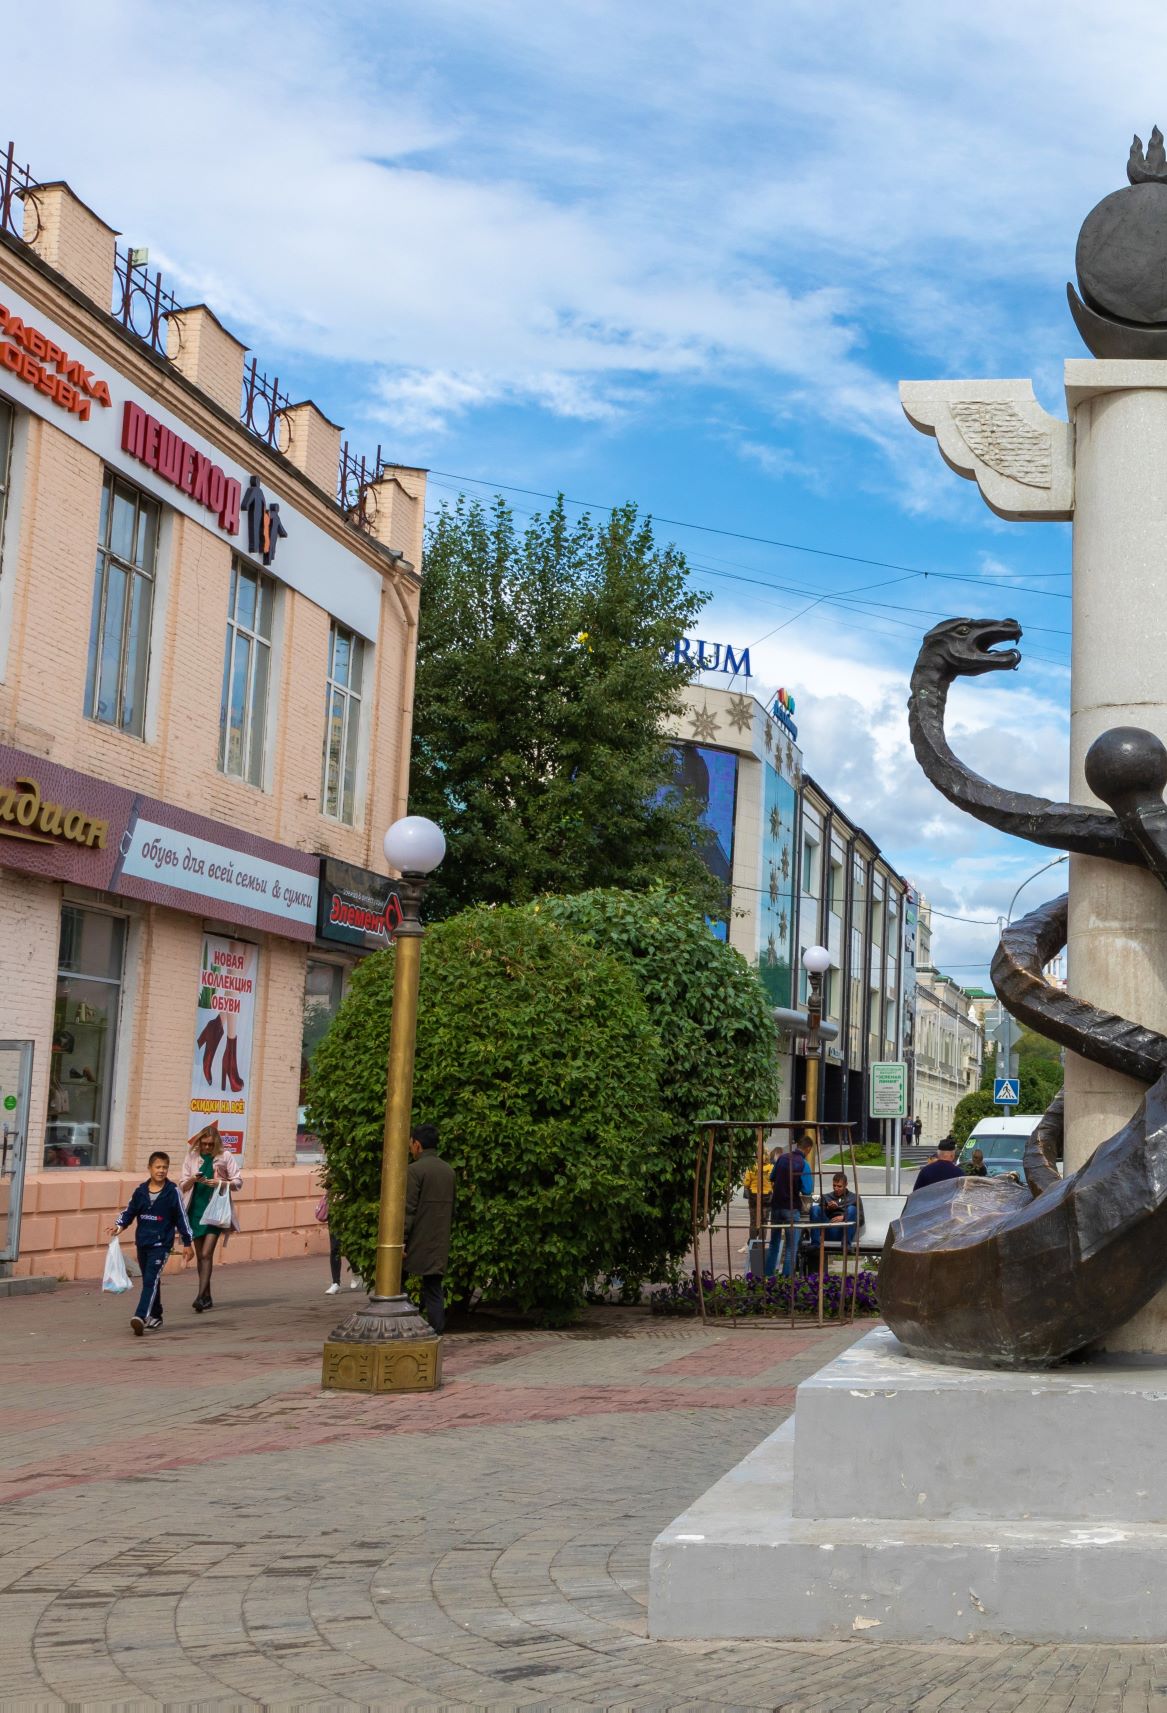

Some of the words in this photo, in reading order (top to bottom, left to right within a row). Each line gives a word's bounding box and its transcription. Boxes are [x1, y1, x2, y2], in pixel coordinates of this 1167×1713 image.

[0, 342, 91, 421] ОБУВИ
[121, 400, 241, 535] ПЕШЕХОД
[672, 636, 753, 677] RUM
[141, 838, 179, 869] обувь
[182, 847, 205, 875] для
[208, 861, 234, 884] всей
[235, 871, 267, 894] семьи
[271, 879, 281, 898] &
[283, 887, 313, 908] сумки
[330, 895, 386, 935] Элемент
[213, 950, 244, 970] НОВАЯ
[201, 971, 253, 993] КОЛЛЕКЦИЯ
[211, 995, 241, 1013] ОБУВИ
[191, 1099, 220, 1114] СКИДКИ
[220, 1100, 230, 1113] НА
